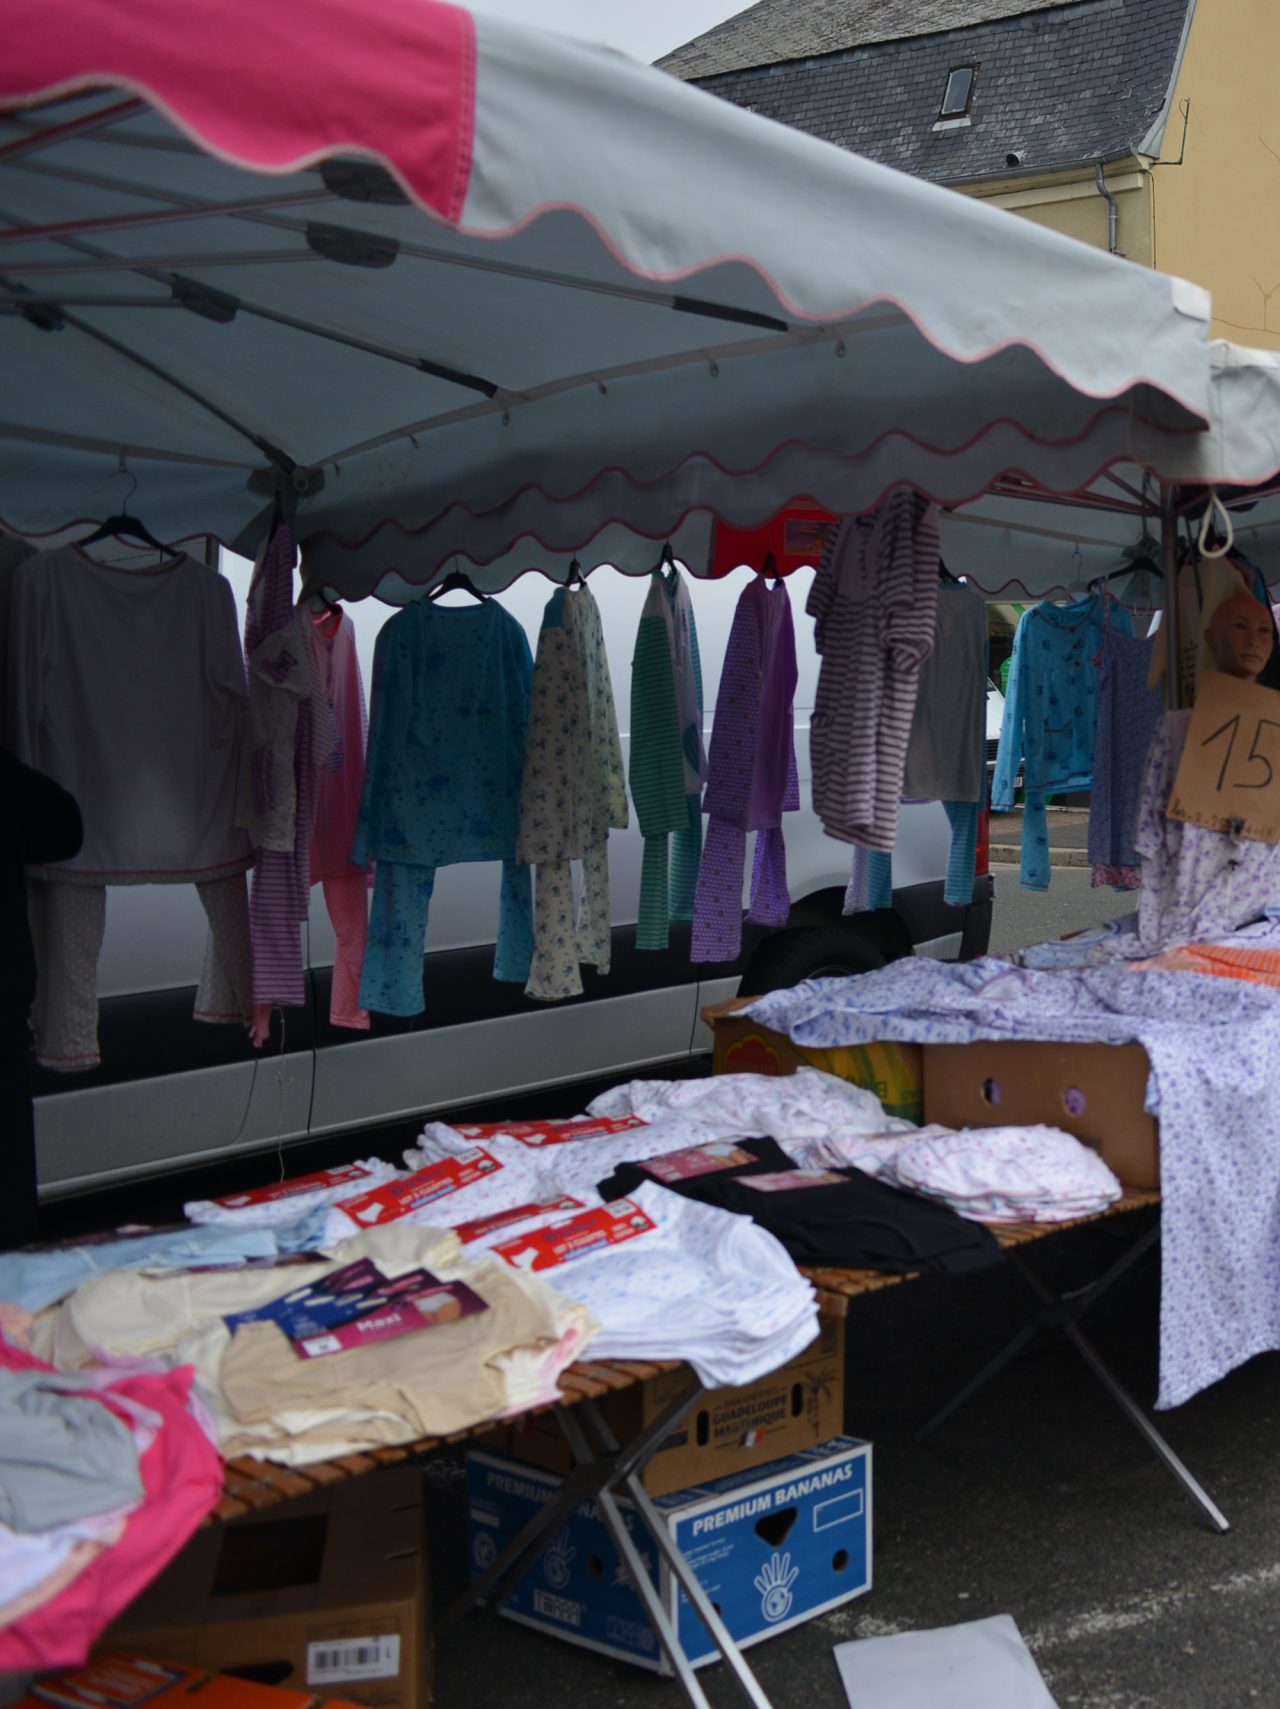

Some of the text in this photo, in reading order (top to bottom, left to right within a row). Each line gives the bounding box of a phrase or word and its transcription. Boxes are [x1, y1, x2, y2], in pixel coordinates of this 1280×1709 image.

[356, 1312, 402, 1333] Maxi
[712, 1394, 787, 1425] GUADELOUPE
[713, 1409, 786, 1439] MARTINIQUE
[692, 1464, 853, 1537] PREMIUM BANANAS
